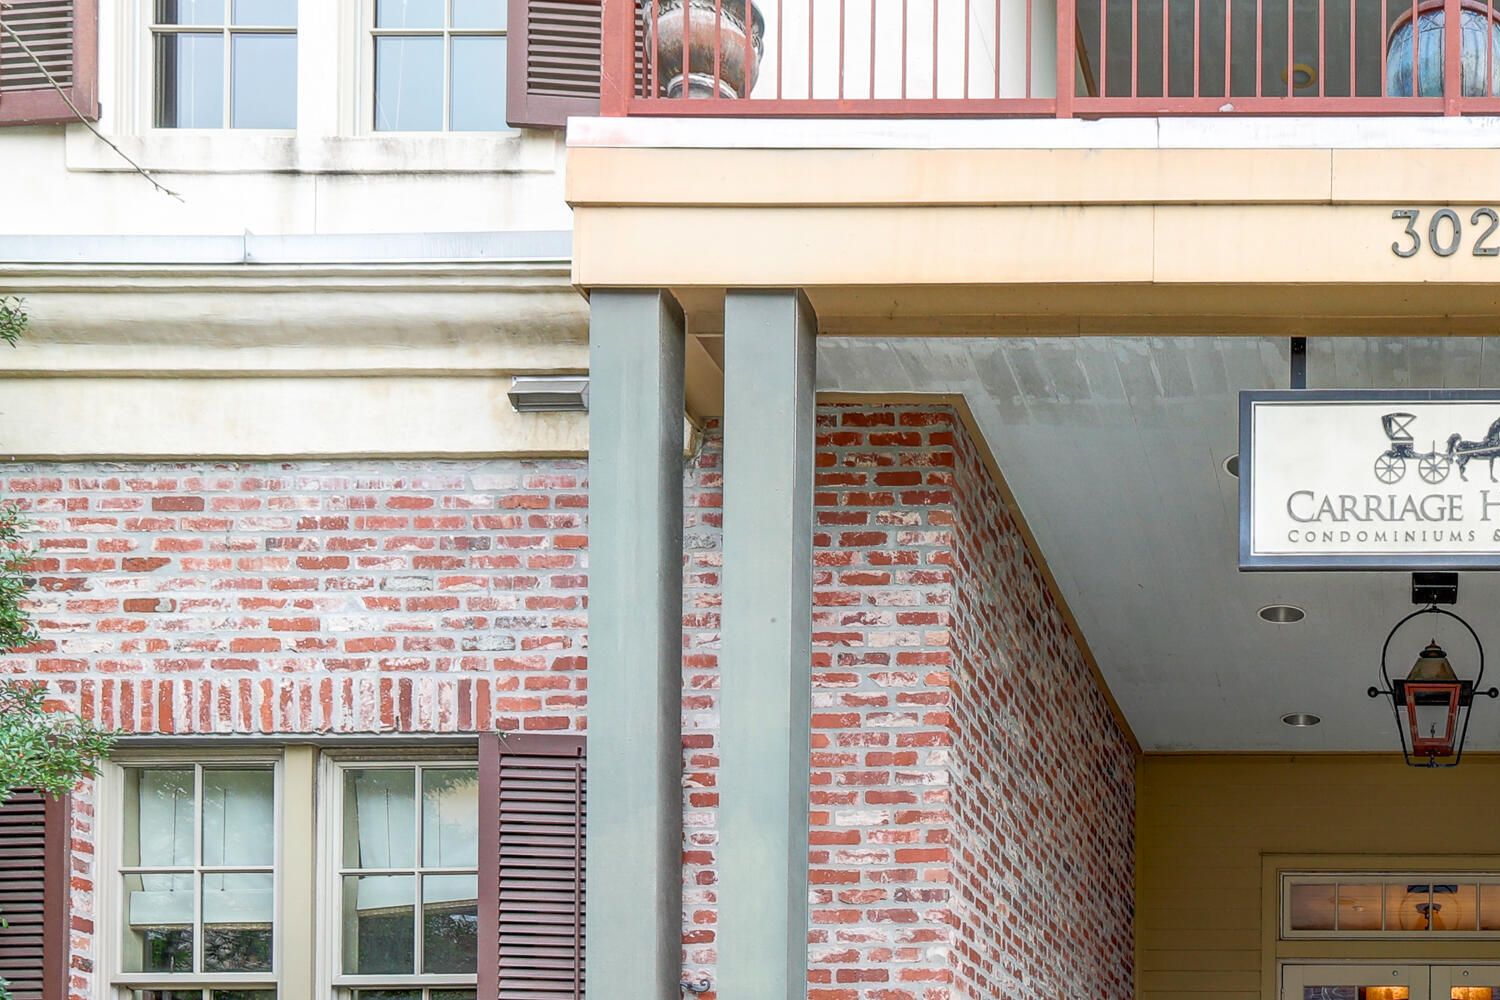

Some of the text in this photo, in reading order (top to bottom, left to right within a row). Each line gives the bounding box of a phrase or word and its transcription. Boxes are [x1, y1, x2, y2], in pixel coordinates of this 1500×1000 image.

[1391, 207, 1500, 258] 302
[1286, 490, 1464, 523] CARRIAGE
[1287, 529, 1476, 543] CONDOMINIUMS
